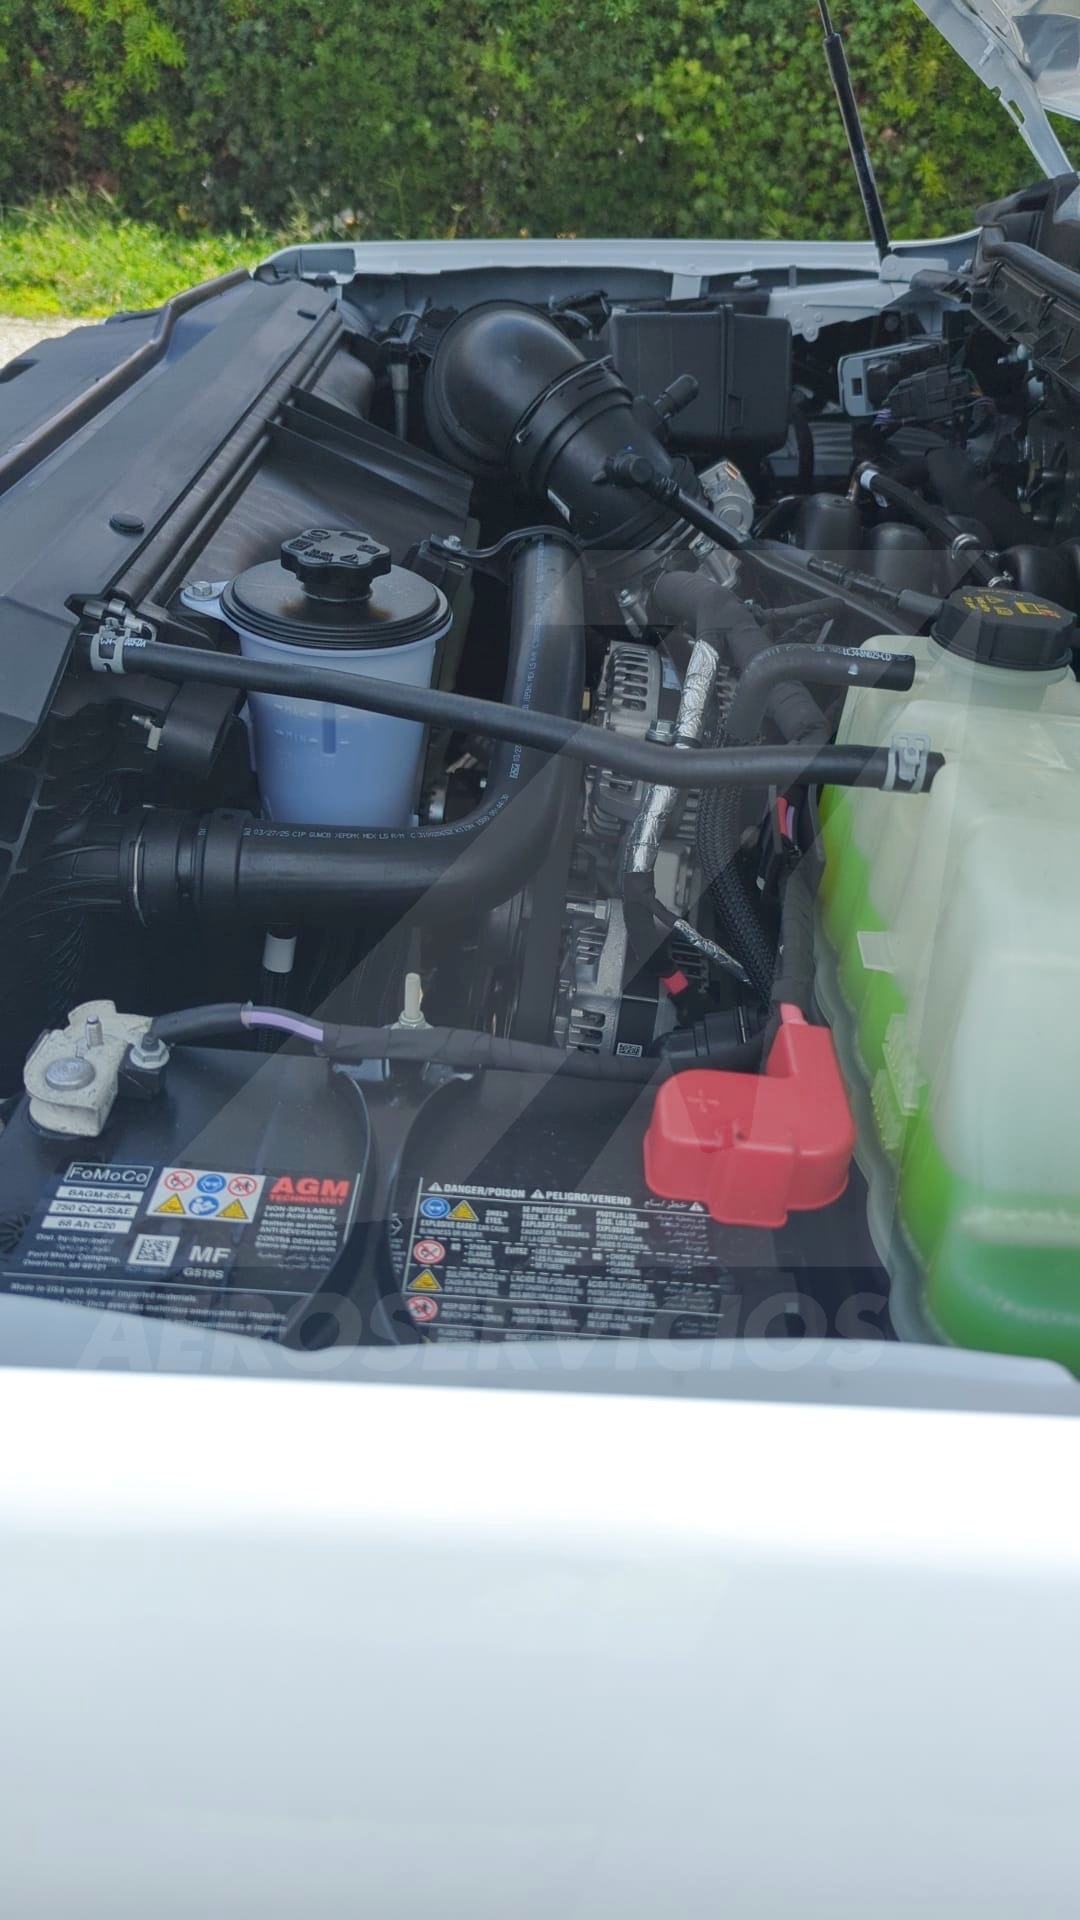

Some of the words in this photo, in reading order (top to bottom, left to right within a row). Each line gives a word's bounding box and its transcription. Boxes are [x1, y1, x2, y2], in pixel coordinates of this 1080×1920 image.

[69, 1166, 148, 1183] FoMoCo
[271, 1176, 351, 1198] AGM
[269, 1195, 346, 1206] TECHNOLOGY
[443, 1183, 527, 1200] DANGER/POISON
[545, 1190, 633, 1206] PELIGRO/VENENO
[78, 1204, 132, 1215] CCA/SAE
[265, 1205, 337, 1214] NON-SPILLABLE
[306, 1213, 338, 1222] Battery
[190, 1245, 231, 1264] MF
